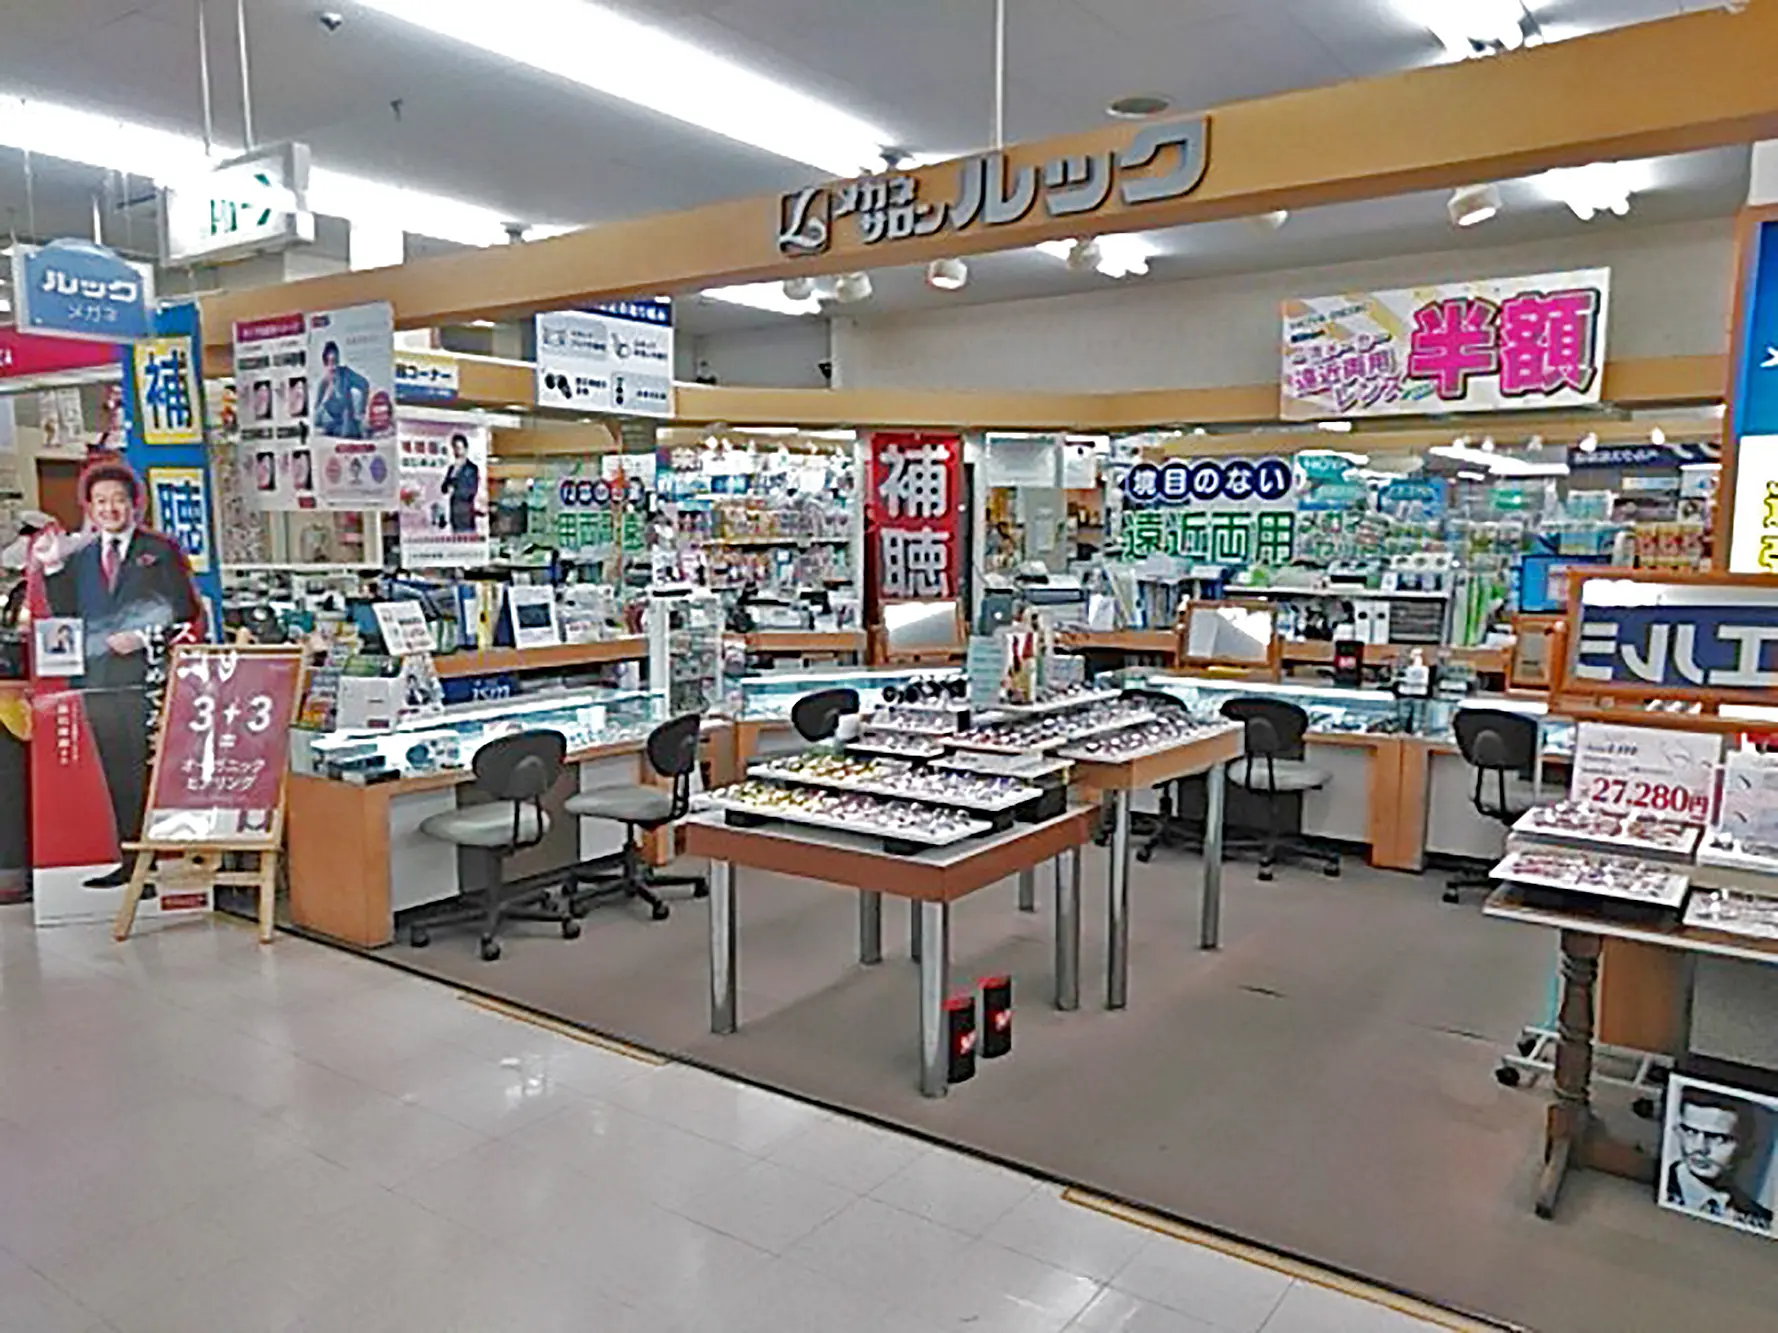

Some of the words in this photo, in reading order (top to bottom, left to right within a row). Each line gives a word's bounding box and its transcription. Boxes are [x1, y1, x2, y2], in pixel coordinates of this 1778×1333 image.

[831, 174, 919, 218] メガネ
[944, 117, 1211, 233] ルック
[860, 201, 949, 244] サロン
[42, 269, 138, 303] ルック
[67, 303, 119, 323] メガネ
[1409, 288, 1600, 400] 半額
[1287, 350, 1394, 392] 遠近両用
[1131, 462, 1287, 497] 境目のない
[878, 442, 952, 597] 補聴
[1122, 511, 1295, 564] 遠近両用
